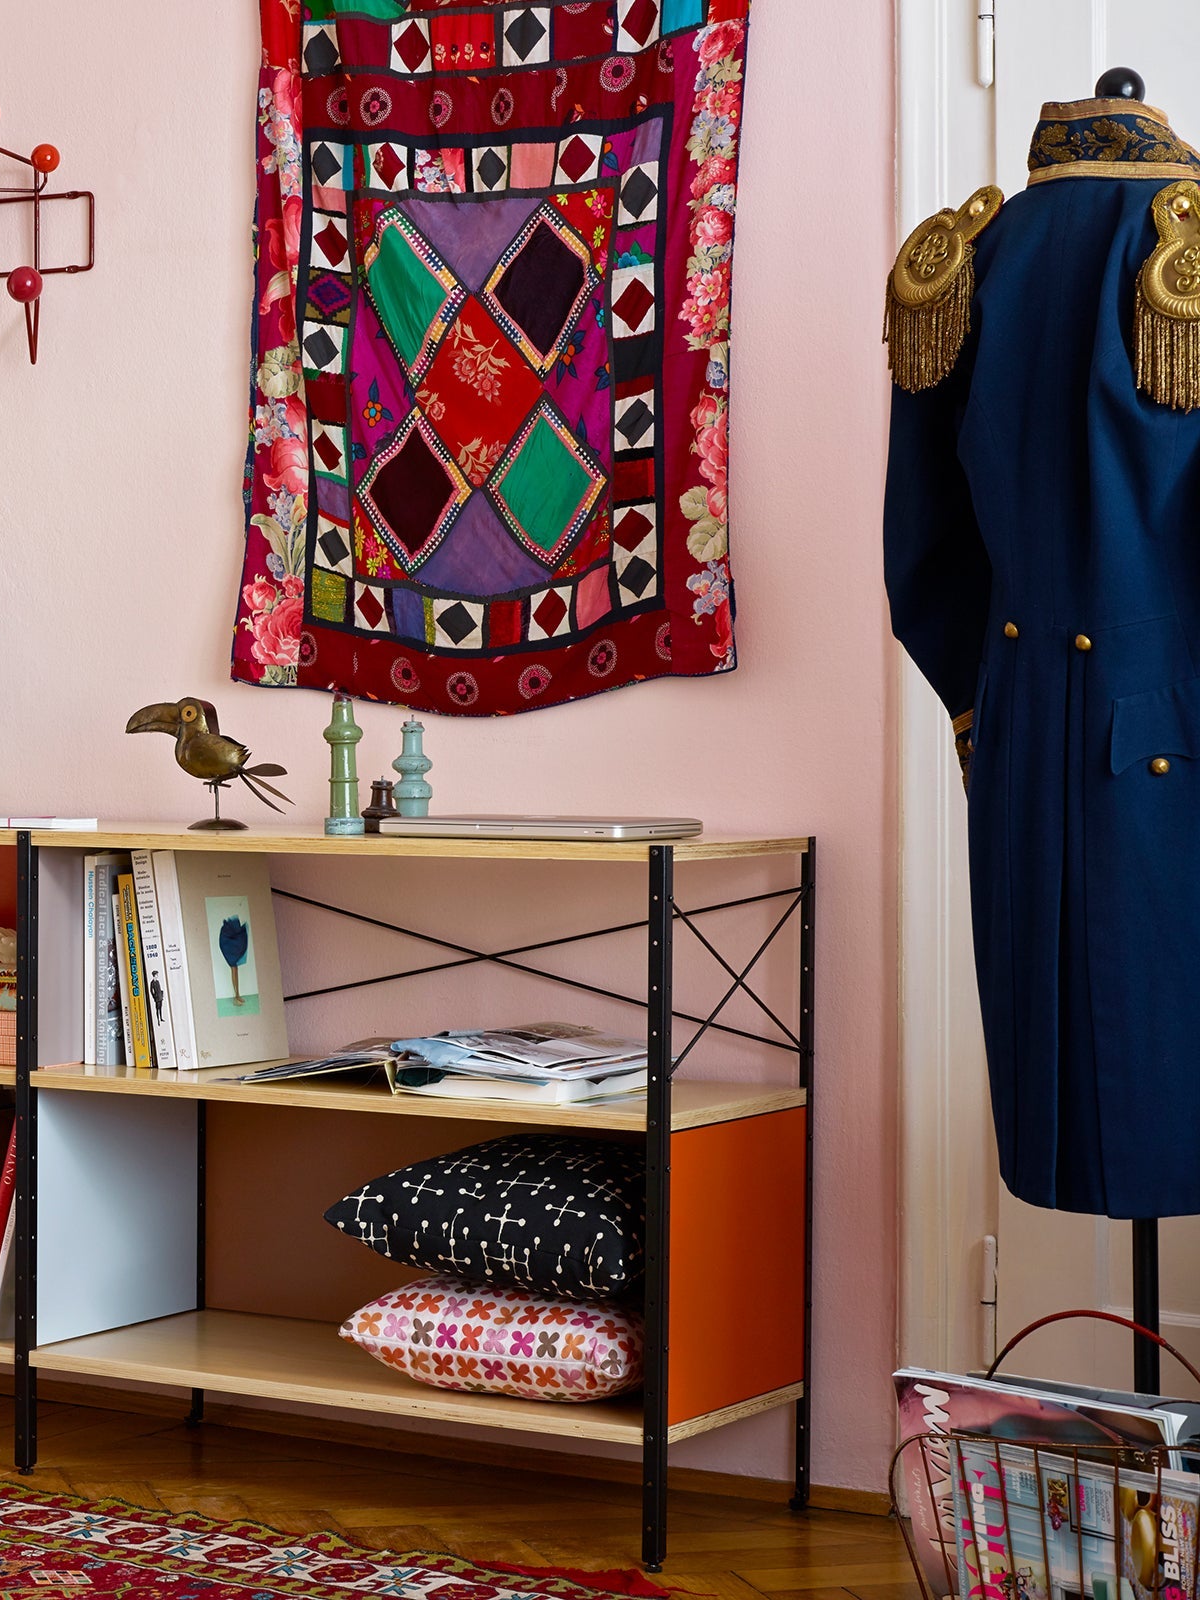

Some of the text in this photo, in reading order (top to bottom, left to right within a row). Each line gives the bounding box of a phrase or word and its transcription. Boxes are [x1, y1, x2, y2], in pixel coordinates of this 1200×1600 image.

[87, 871, 95, 938] Hussein Chalayan
[126, 922, 136, 955] BACK
[96, 868, 109, 1065] radical lace & subversive knitting
[971, 1482, 991, 1585] LIVING
[1160, 1505, 1181, 1581] BLISS
